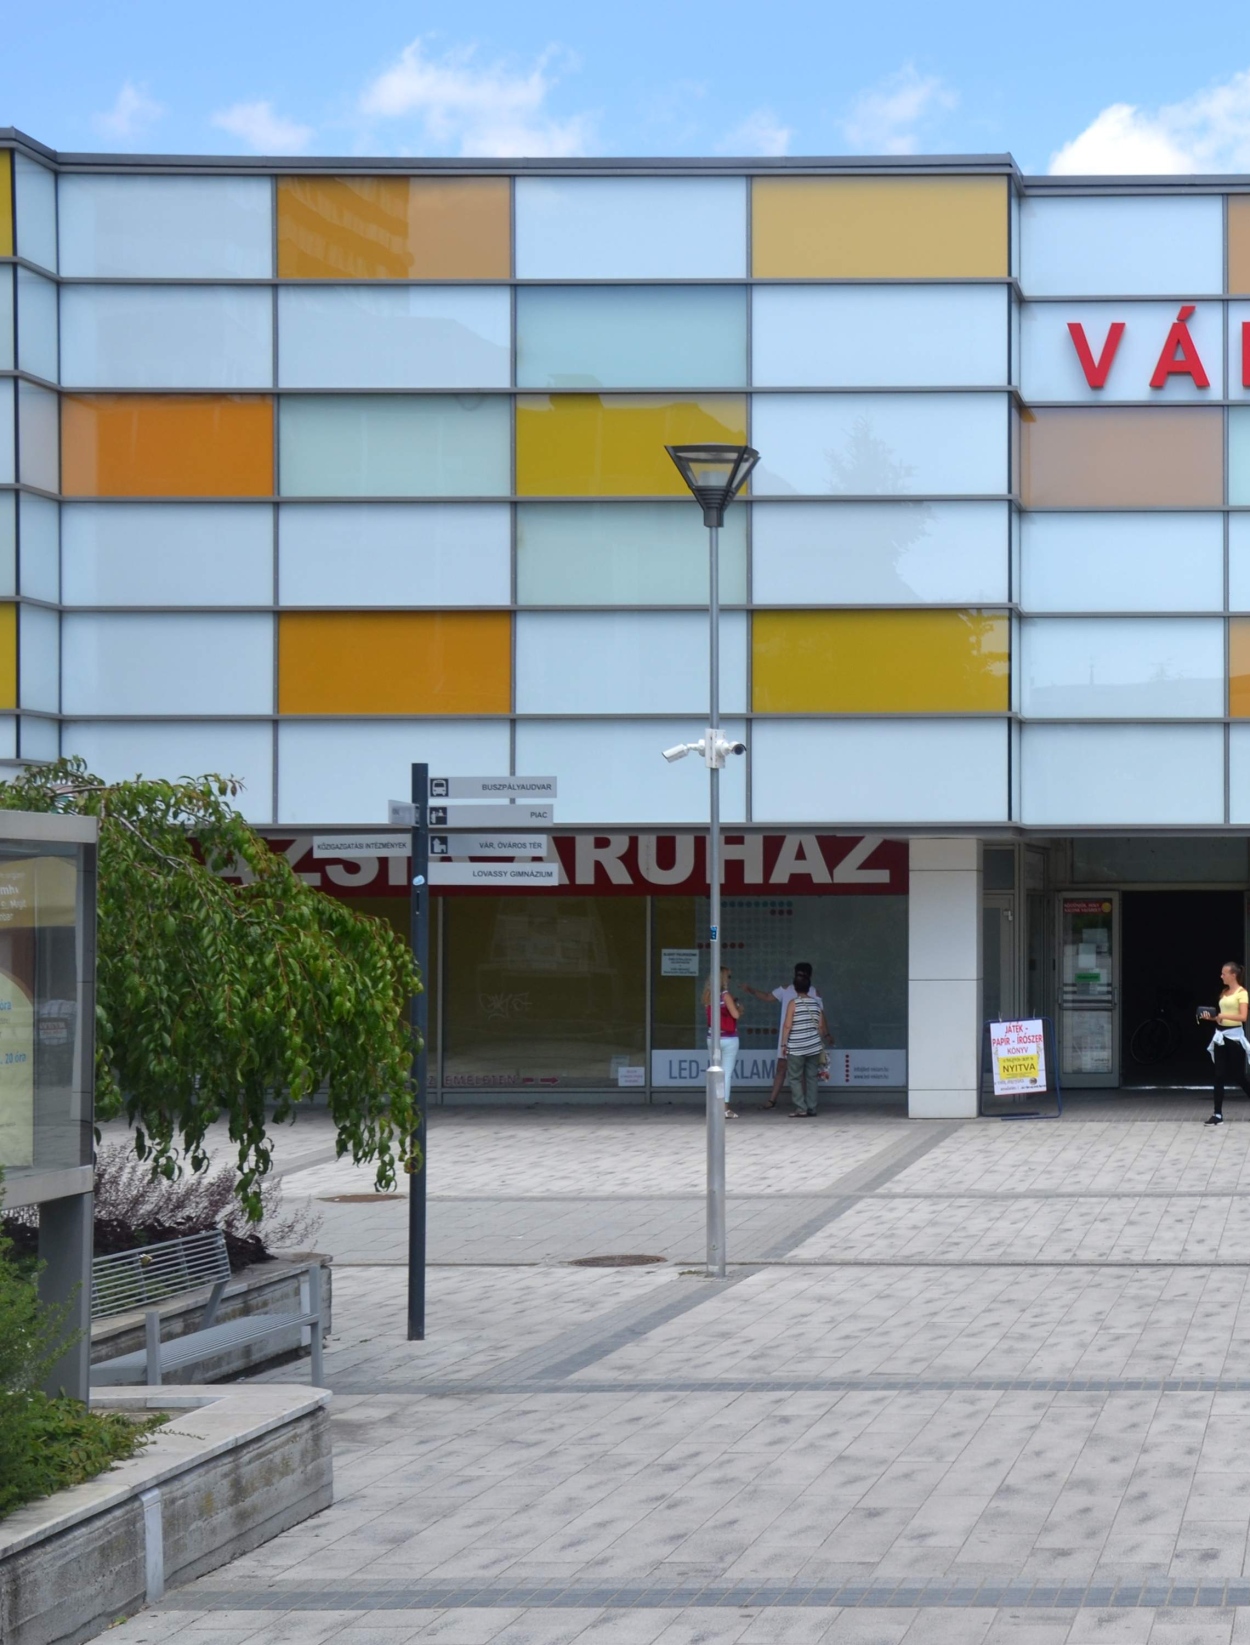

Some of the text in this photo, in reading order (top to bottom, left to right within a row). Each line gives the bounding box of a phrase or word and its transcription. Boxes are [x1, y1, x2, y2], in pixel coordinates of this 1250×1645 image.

[481, 782, 552, 791] BUSZPÁLYAUDVAR
[530, 811, 548, 819] PIAC
[365, 841, 407, 850] INTÉZMÉNYEK
[479, 841, 496, 850] VÁR,
[527, 841, 543, 849] TÉR
[472, 869, 554, 879] LOVASSY GIMNÁZIUM
[1005, 1022, 1024, 1034] JÁTÉK
[992, 1034, 1010, 1046] PAPÍR
[1007, 1046, 1029, 1055] KÖNYV
[1002, 1063, 1036, 1074] NYITVA
